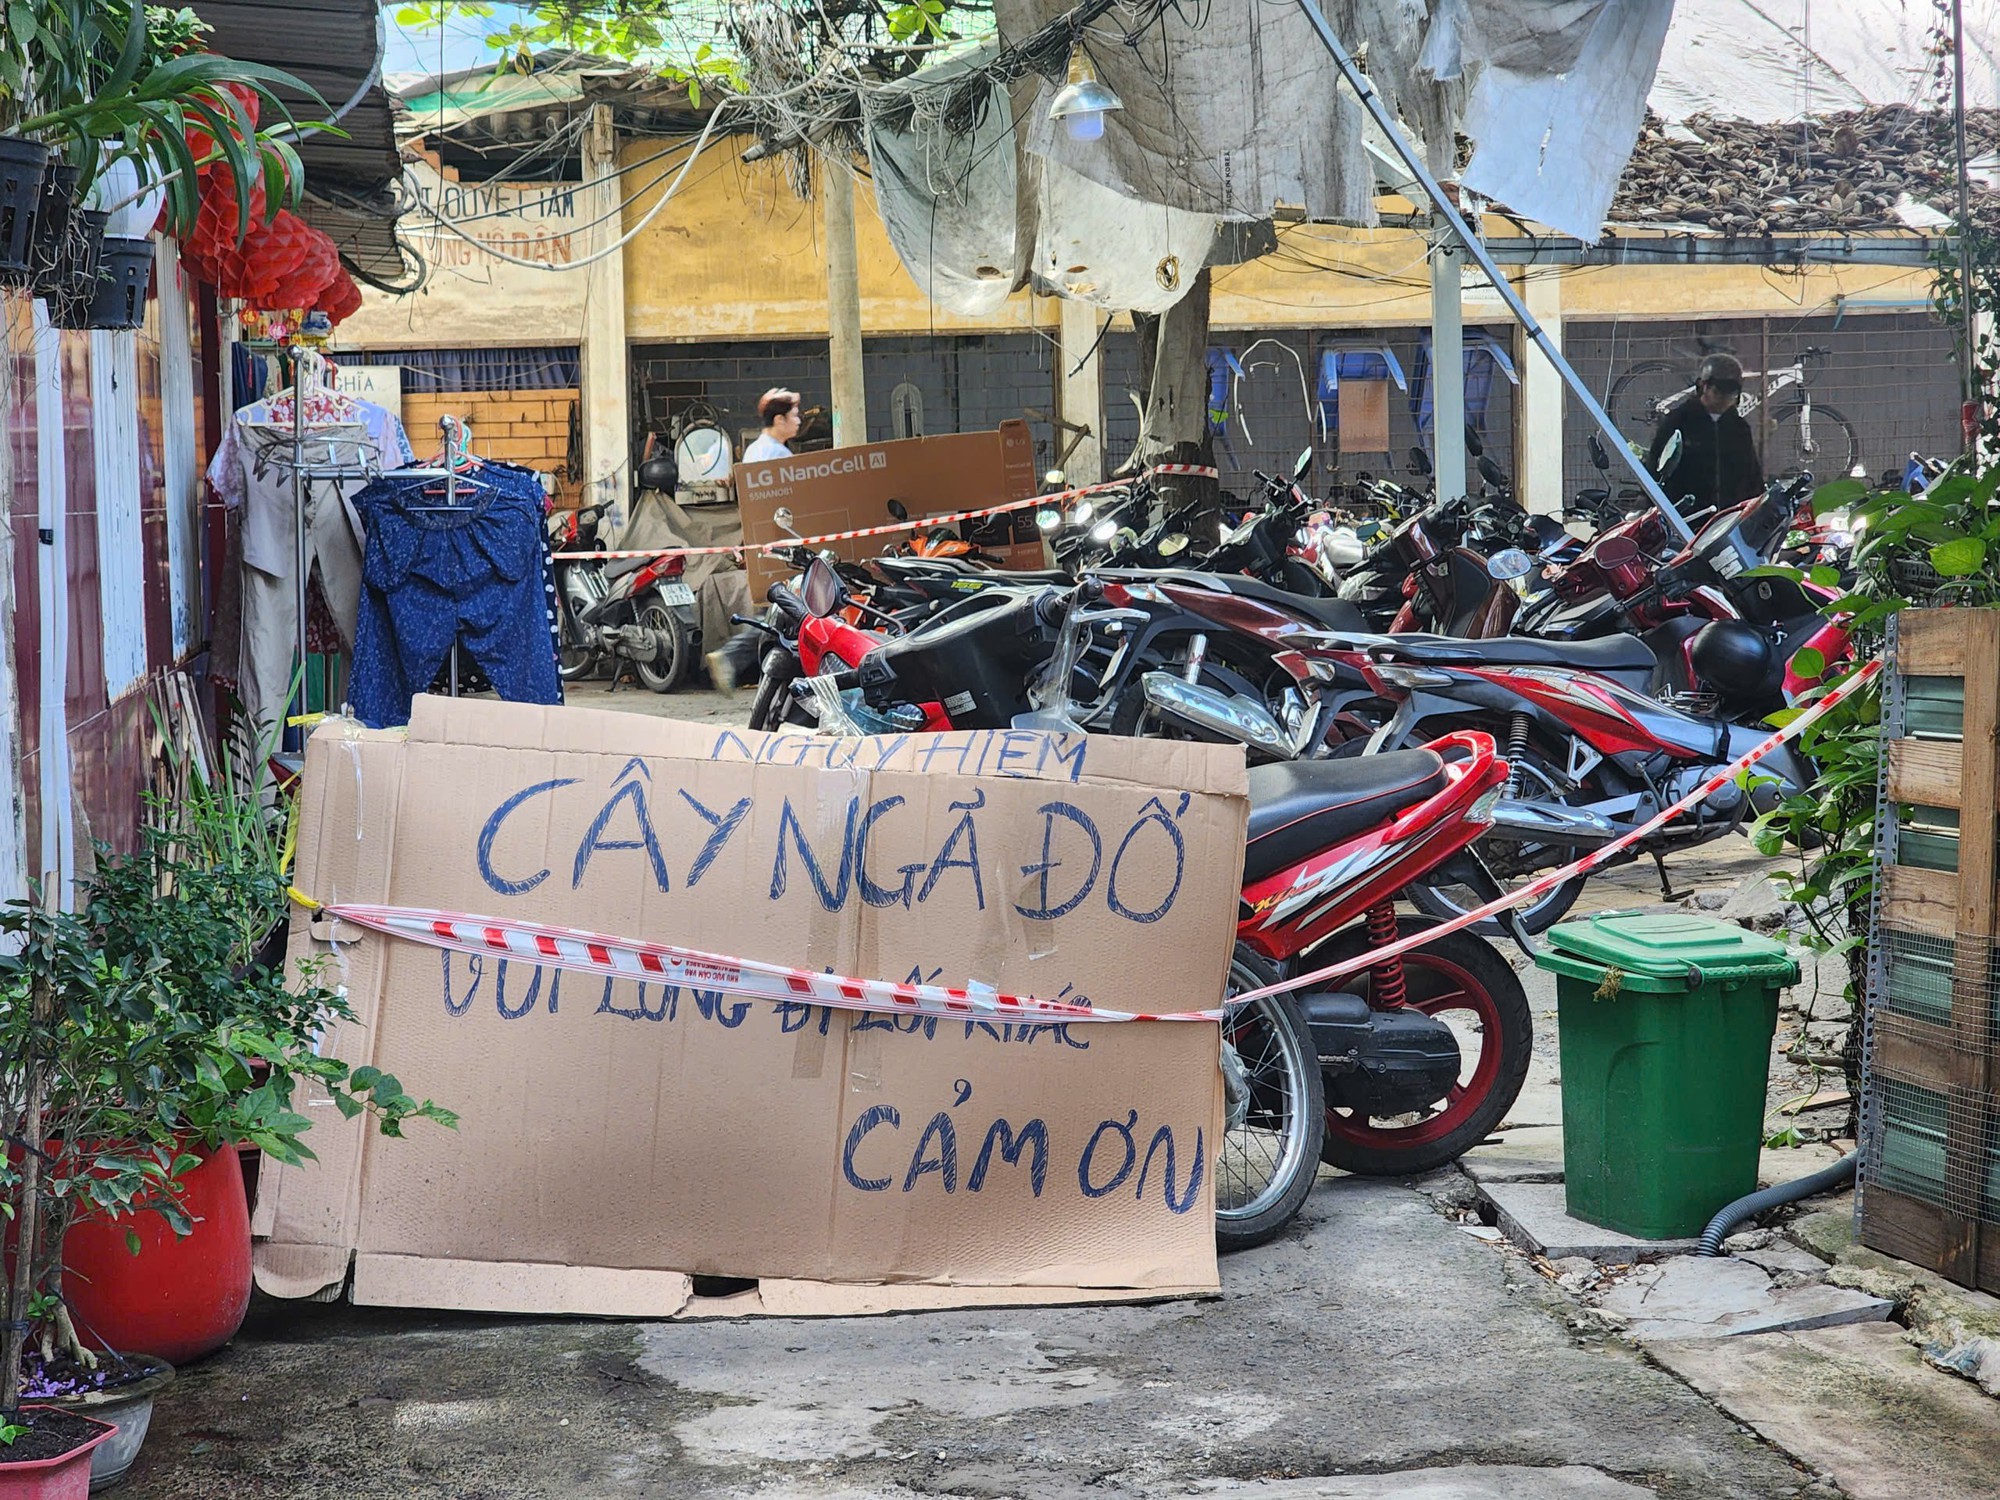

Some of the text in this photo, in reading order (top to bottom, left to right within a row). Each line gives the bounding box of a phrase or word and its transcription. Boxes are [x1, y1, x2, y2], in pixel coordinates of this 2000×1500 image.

[746, 469, 774, 488] LG
[780, 454, 866, 483] NanoCell
[1017, 515, 1034, 529] 55
[477, 757, 754, 897] CÂY
[842, 1078, 1204, 1215] CẢM ƠN
